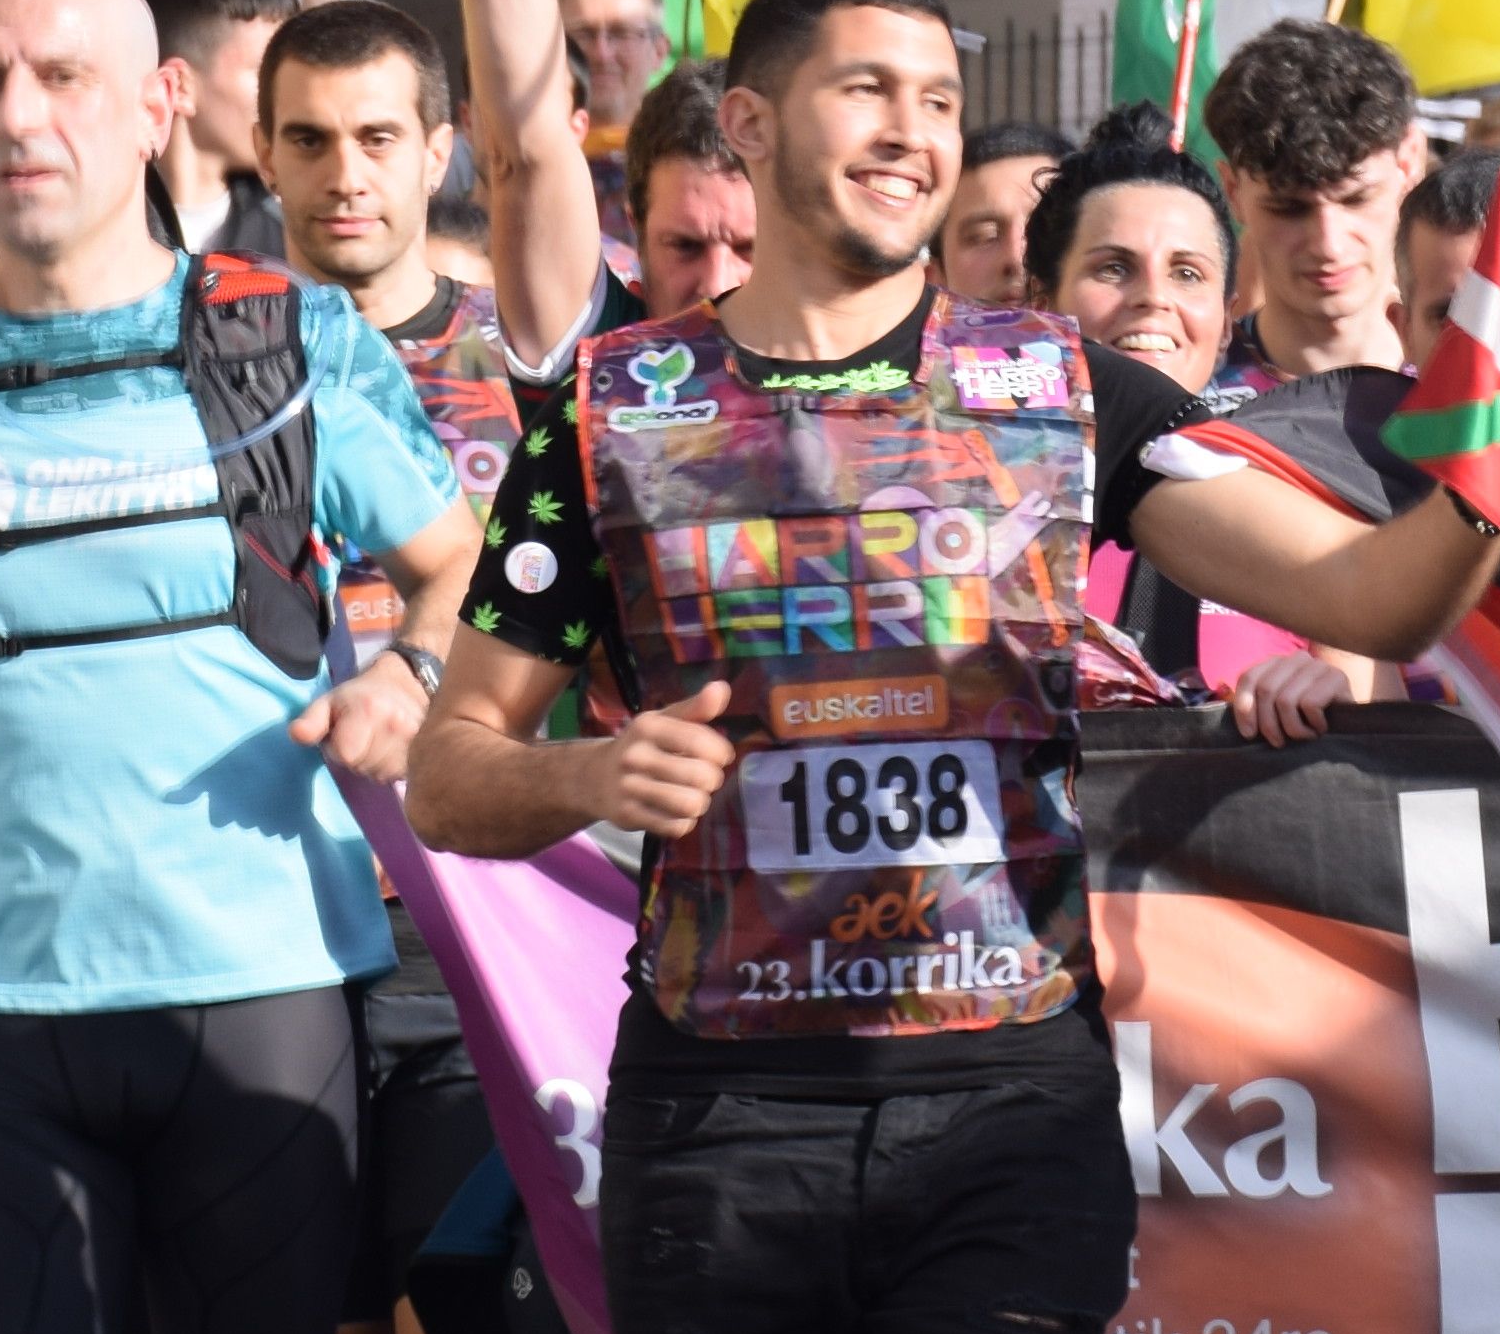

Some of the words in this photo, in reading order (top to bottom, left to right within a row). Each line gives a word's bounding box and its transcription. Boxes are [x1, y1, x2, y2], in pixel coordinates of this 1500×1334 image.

[645, 508, 989, 599] HARRO
[781, 685, 933, 725] euskaltel
[779, 752, 968, 856] 1838
[829, 869, 941, 943] aek
[737, 930, 1025, 1003] 23.korrika
